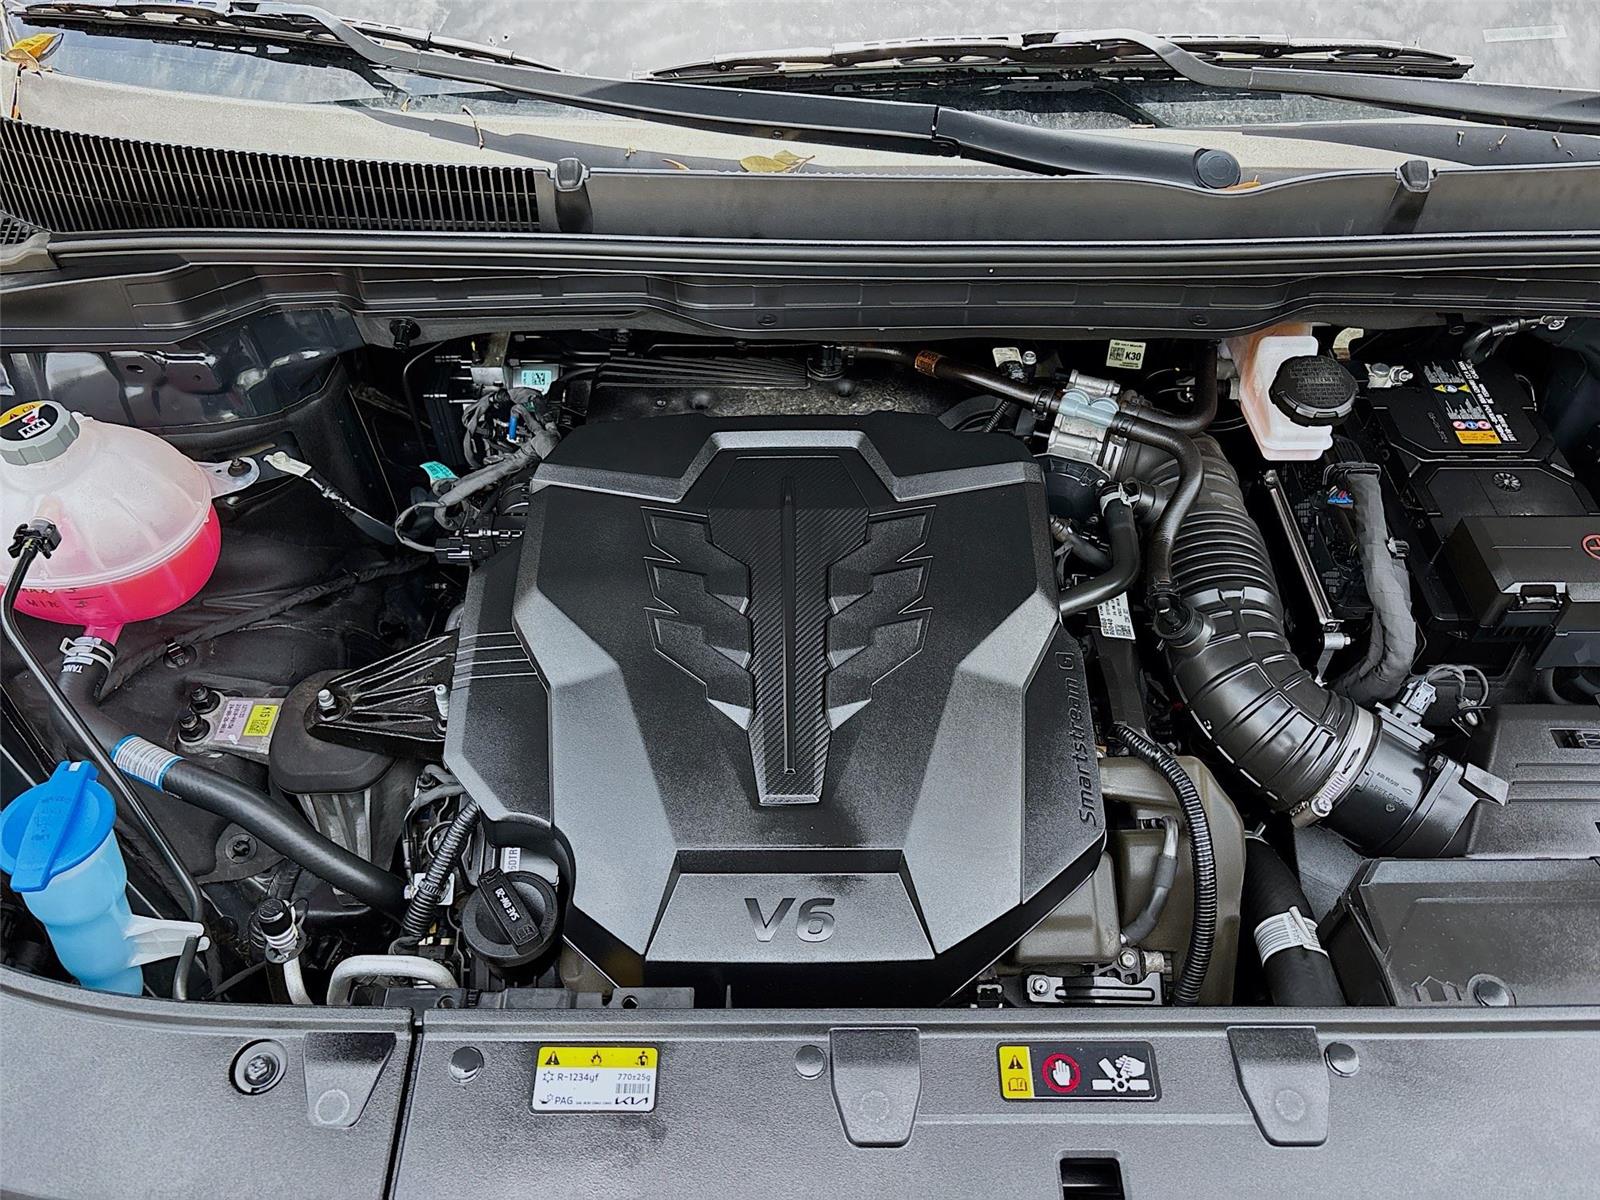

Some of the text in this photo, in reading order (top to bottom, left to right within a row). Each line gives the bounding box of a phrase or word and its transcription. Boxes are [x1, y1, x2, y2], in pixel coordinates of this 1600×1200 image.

[1125, 351, 1142, 361] K30
[1055, 651, 1097, 827] Smartstream G
[506, 905, 520, 921] SAE
[743, 897, 836, 943] V6
[557, 1073, 600, 1083] R-1234yf
[554, 1096, 574, 1105] PAG
[615, 1096, 649, 1105] KIA
